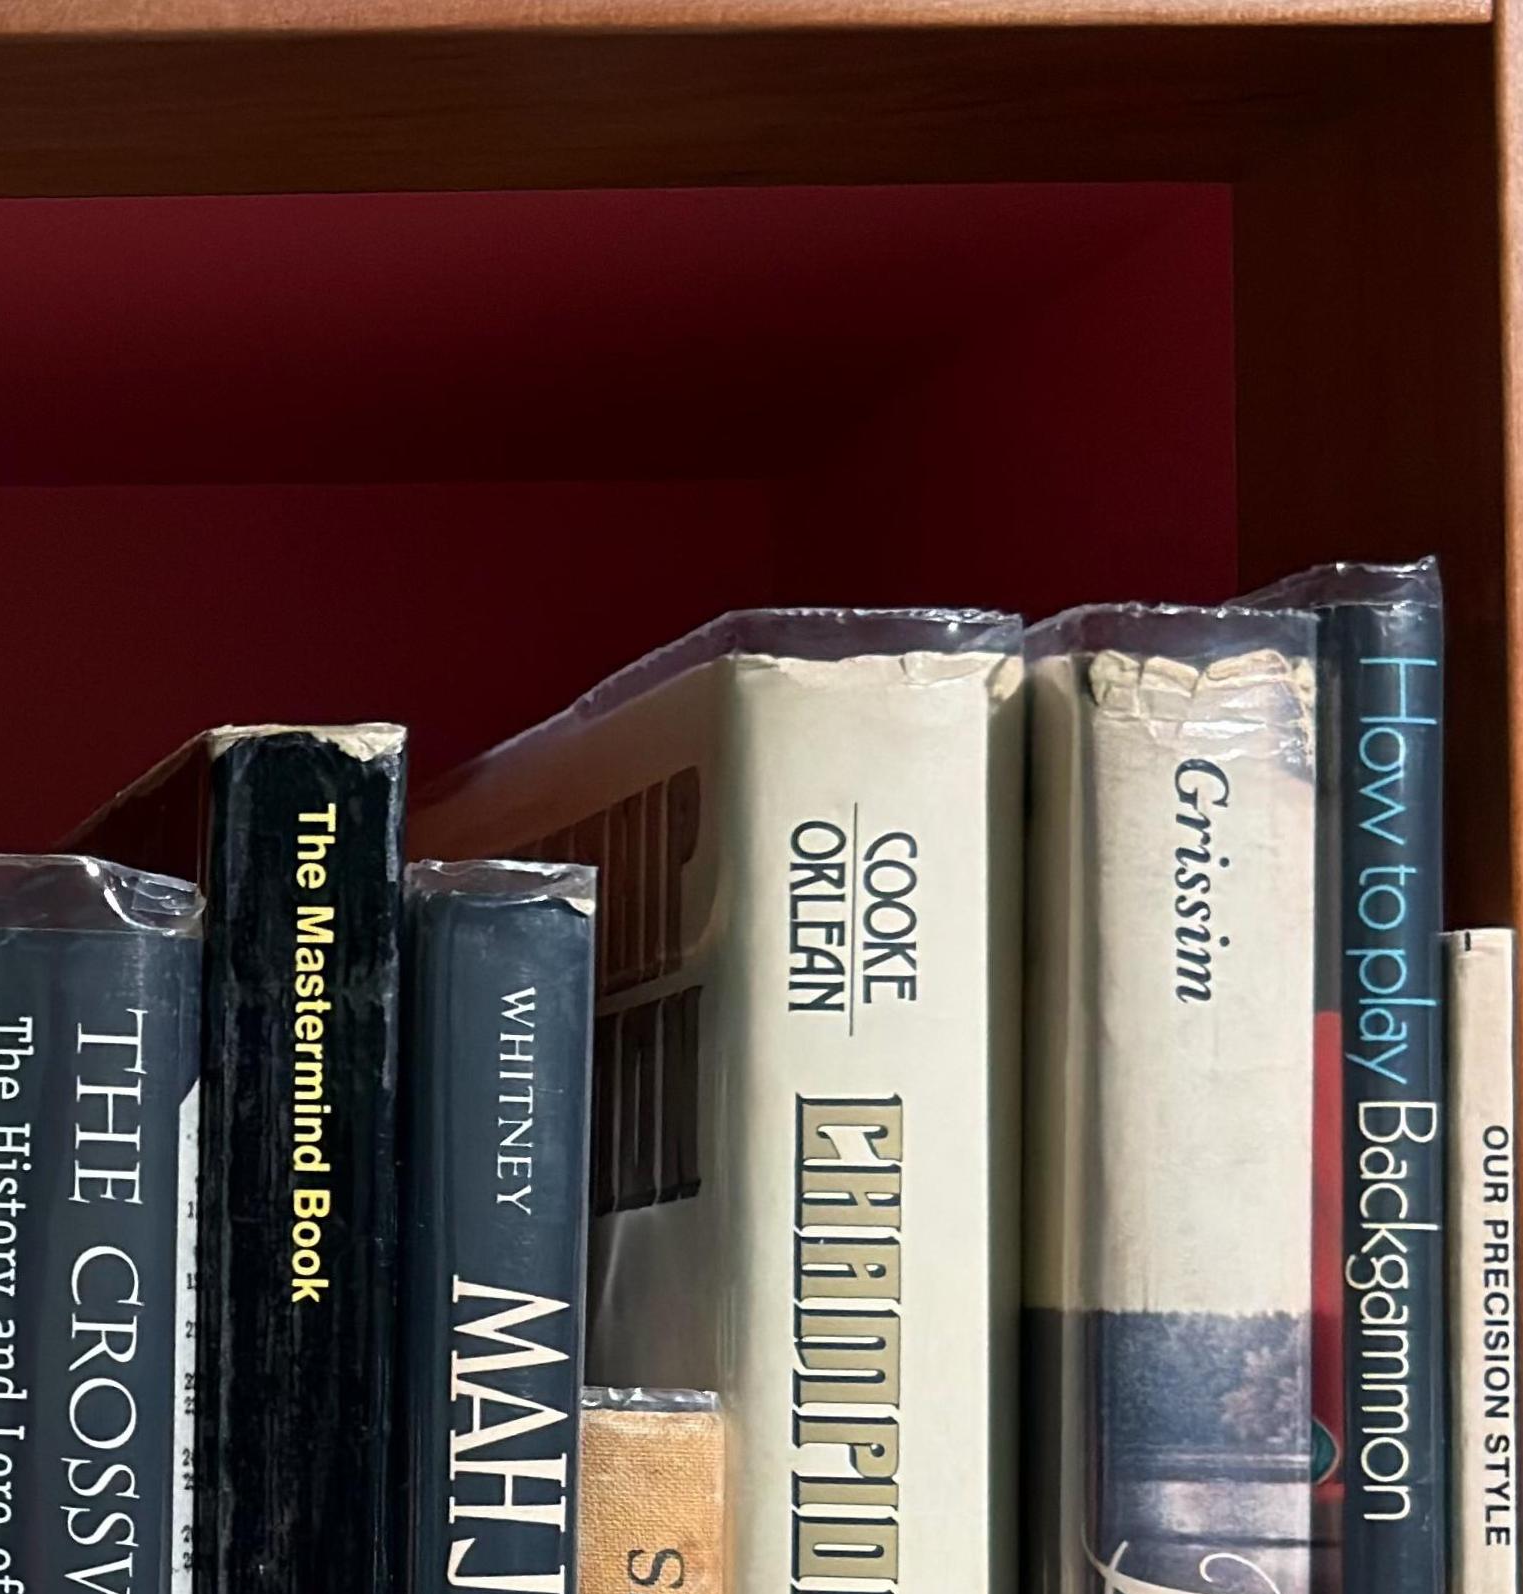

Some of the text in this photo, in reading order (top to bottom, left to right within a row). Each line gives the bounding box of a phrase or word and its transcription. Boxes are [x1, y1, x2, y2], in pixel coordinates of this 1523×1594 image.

[788, 820, 847, 1013] ORLEAN
[863, 831, 918, 1005] COOKE
[1174, 759, 1230, 1004] Grissim
[69, 1007, 148, 1204] THE
[290, 803, 336, 1303] The Mastermind Book
[496, 986, 537, 1215] WHITNEY
[1345, 657, 1439, 1521] How to play Backgammon
[1482, 1125, 1512, 1547] OUR PRECISION STYLE
